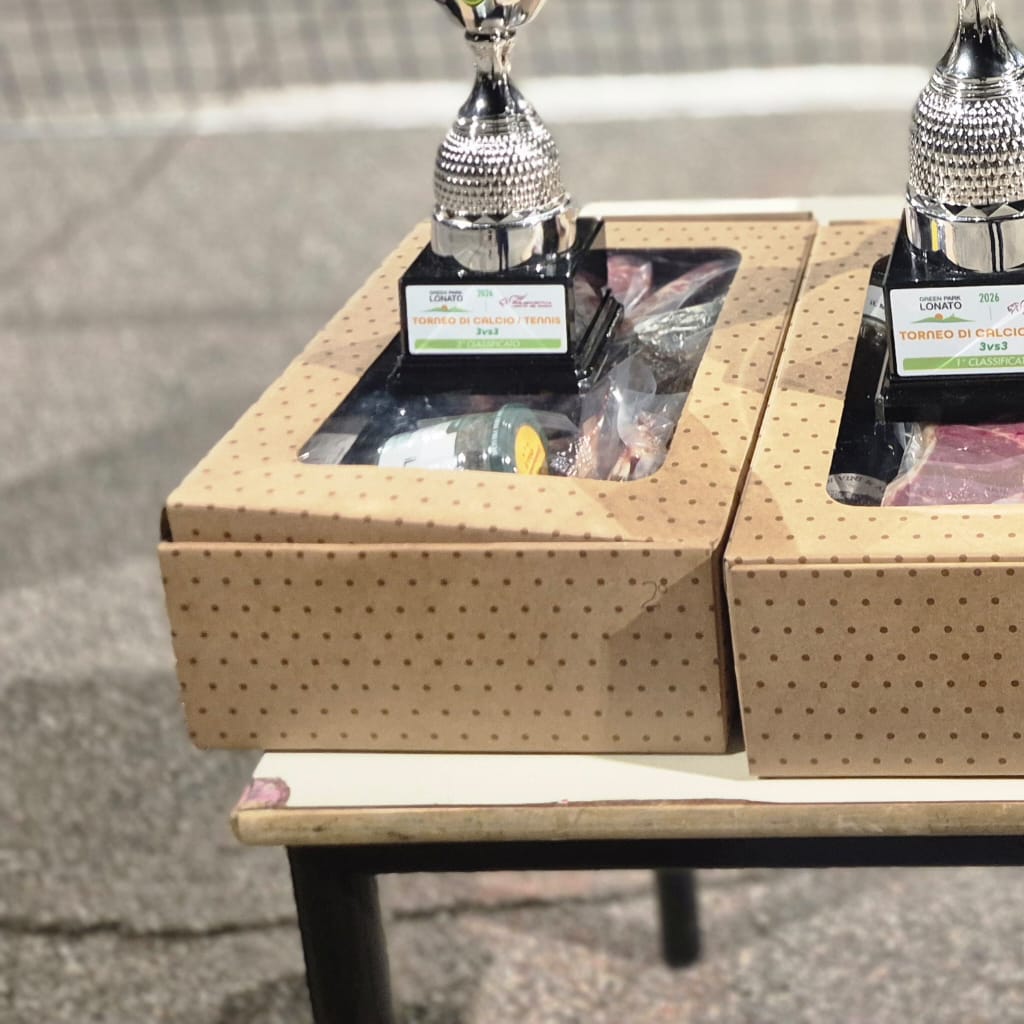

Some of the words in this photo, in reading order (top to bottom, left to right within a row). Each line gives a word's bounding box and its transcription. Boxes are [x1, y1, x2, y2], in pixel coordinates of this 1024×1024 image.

[979, 292, 1000, 303] 2026
[919, 301, 962, 311] LONATO
[413, 316, 456, 326] TORNEO
[459, 316, 470, 325] DI
[473, 316, 515, 325] CALCIO
[525, 315, 561, 325] TENNIS
[475, 328, 499, 336] 3vs3
[900, 329, 954, 341] TORNEO
[958, 329, 972, 339] DI
[979, 341, 1009, 352] 3vs3
